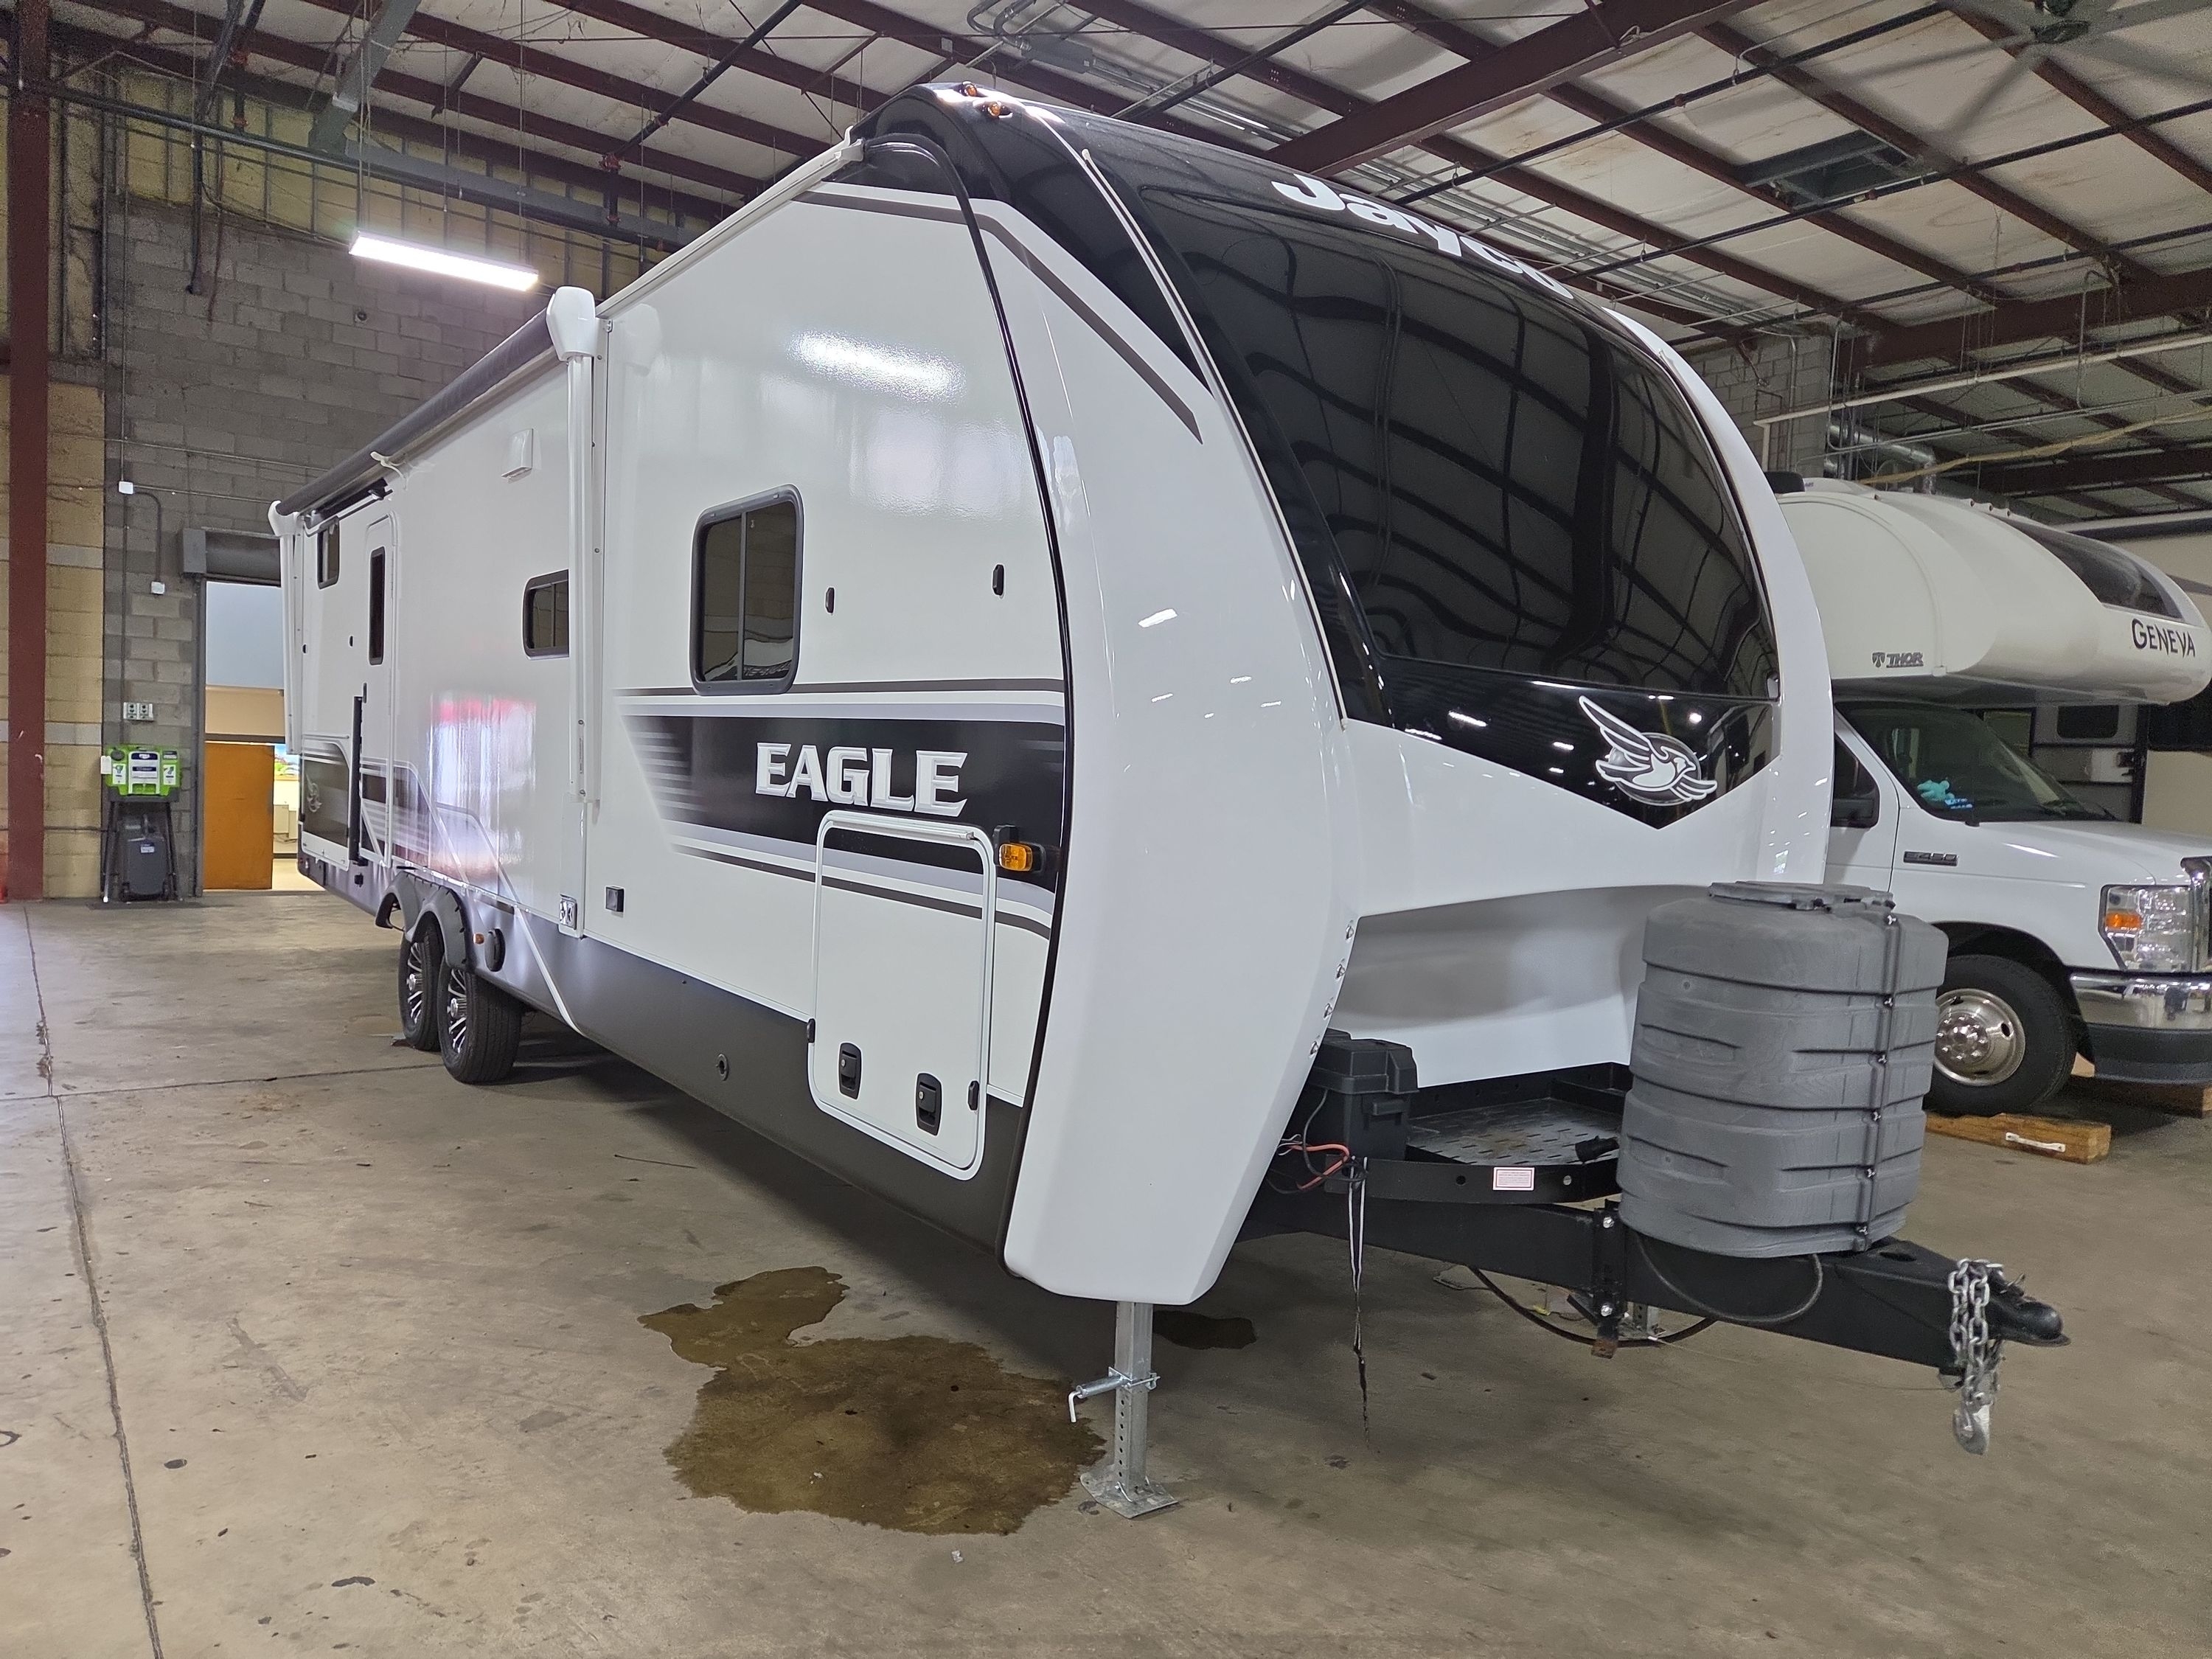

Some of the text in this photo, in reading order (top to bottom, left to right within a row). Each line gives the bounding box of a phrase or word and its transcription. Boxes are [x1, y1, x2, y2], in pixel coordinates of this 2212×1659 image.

[2132, 618, 2196, 658] GENEVA
[1886, 653, 1923, 666] THOR
[755, 742, 968, 817] EAGLE
